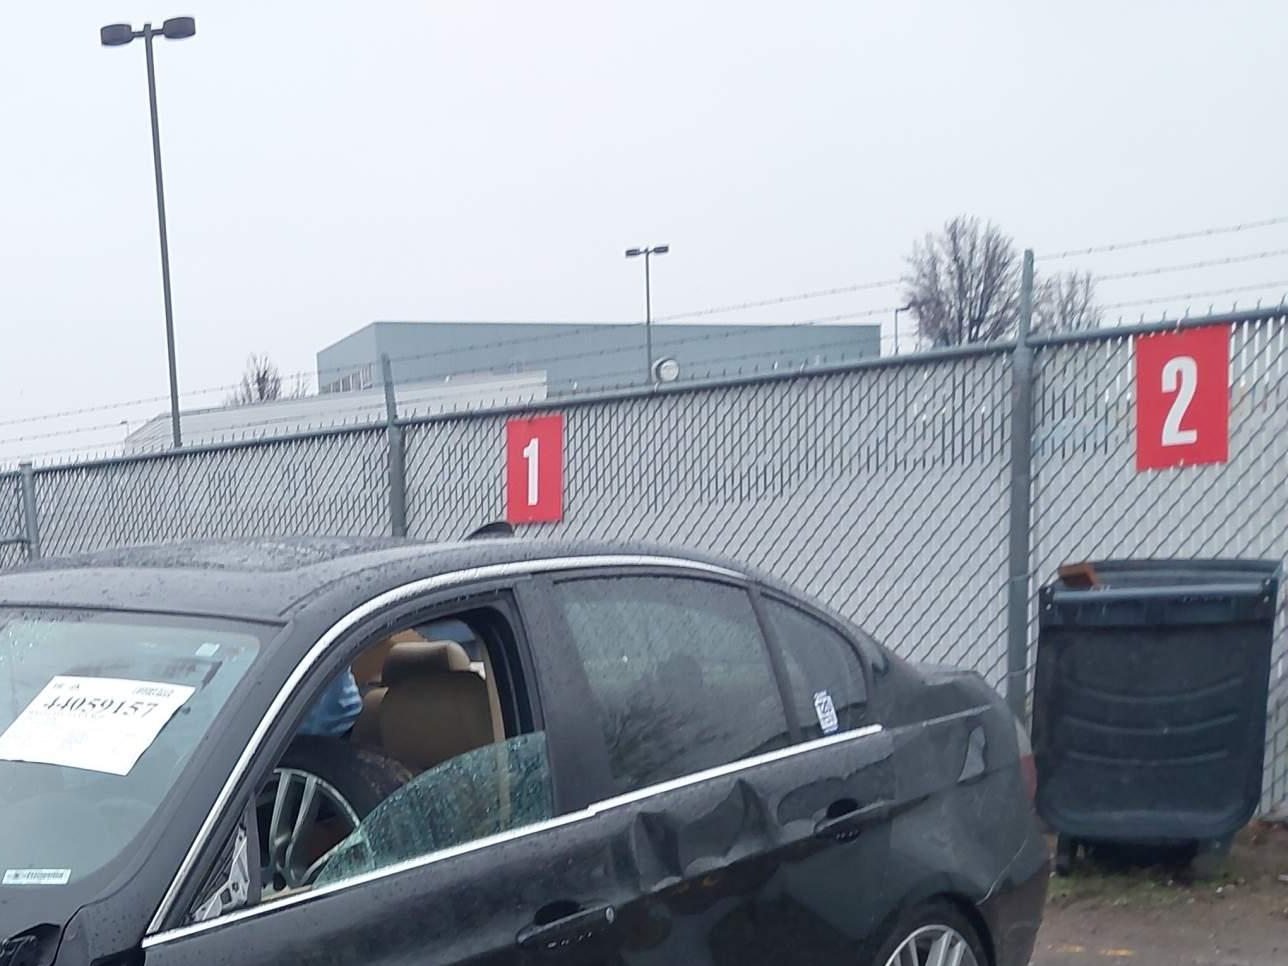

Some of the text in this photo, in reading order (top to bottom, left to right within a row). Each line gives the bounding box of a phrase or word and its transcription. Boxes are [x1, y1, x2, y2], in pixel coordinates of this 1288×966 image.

[1161, 355, 1198, 447] 2
[523, 437, 539, 506] 1
[43, 695, 159, 719] 44059157
